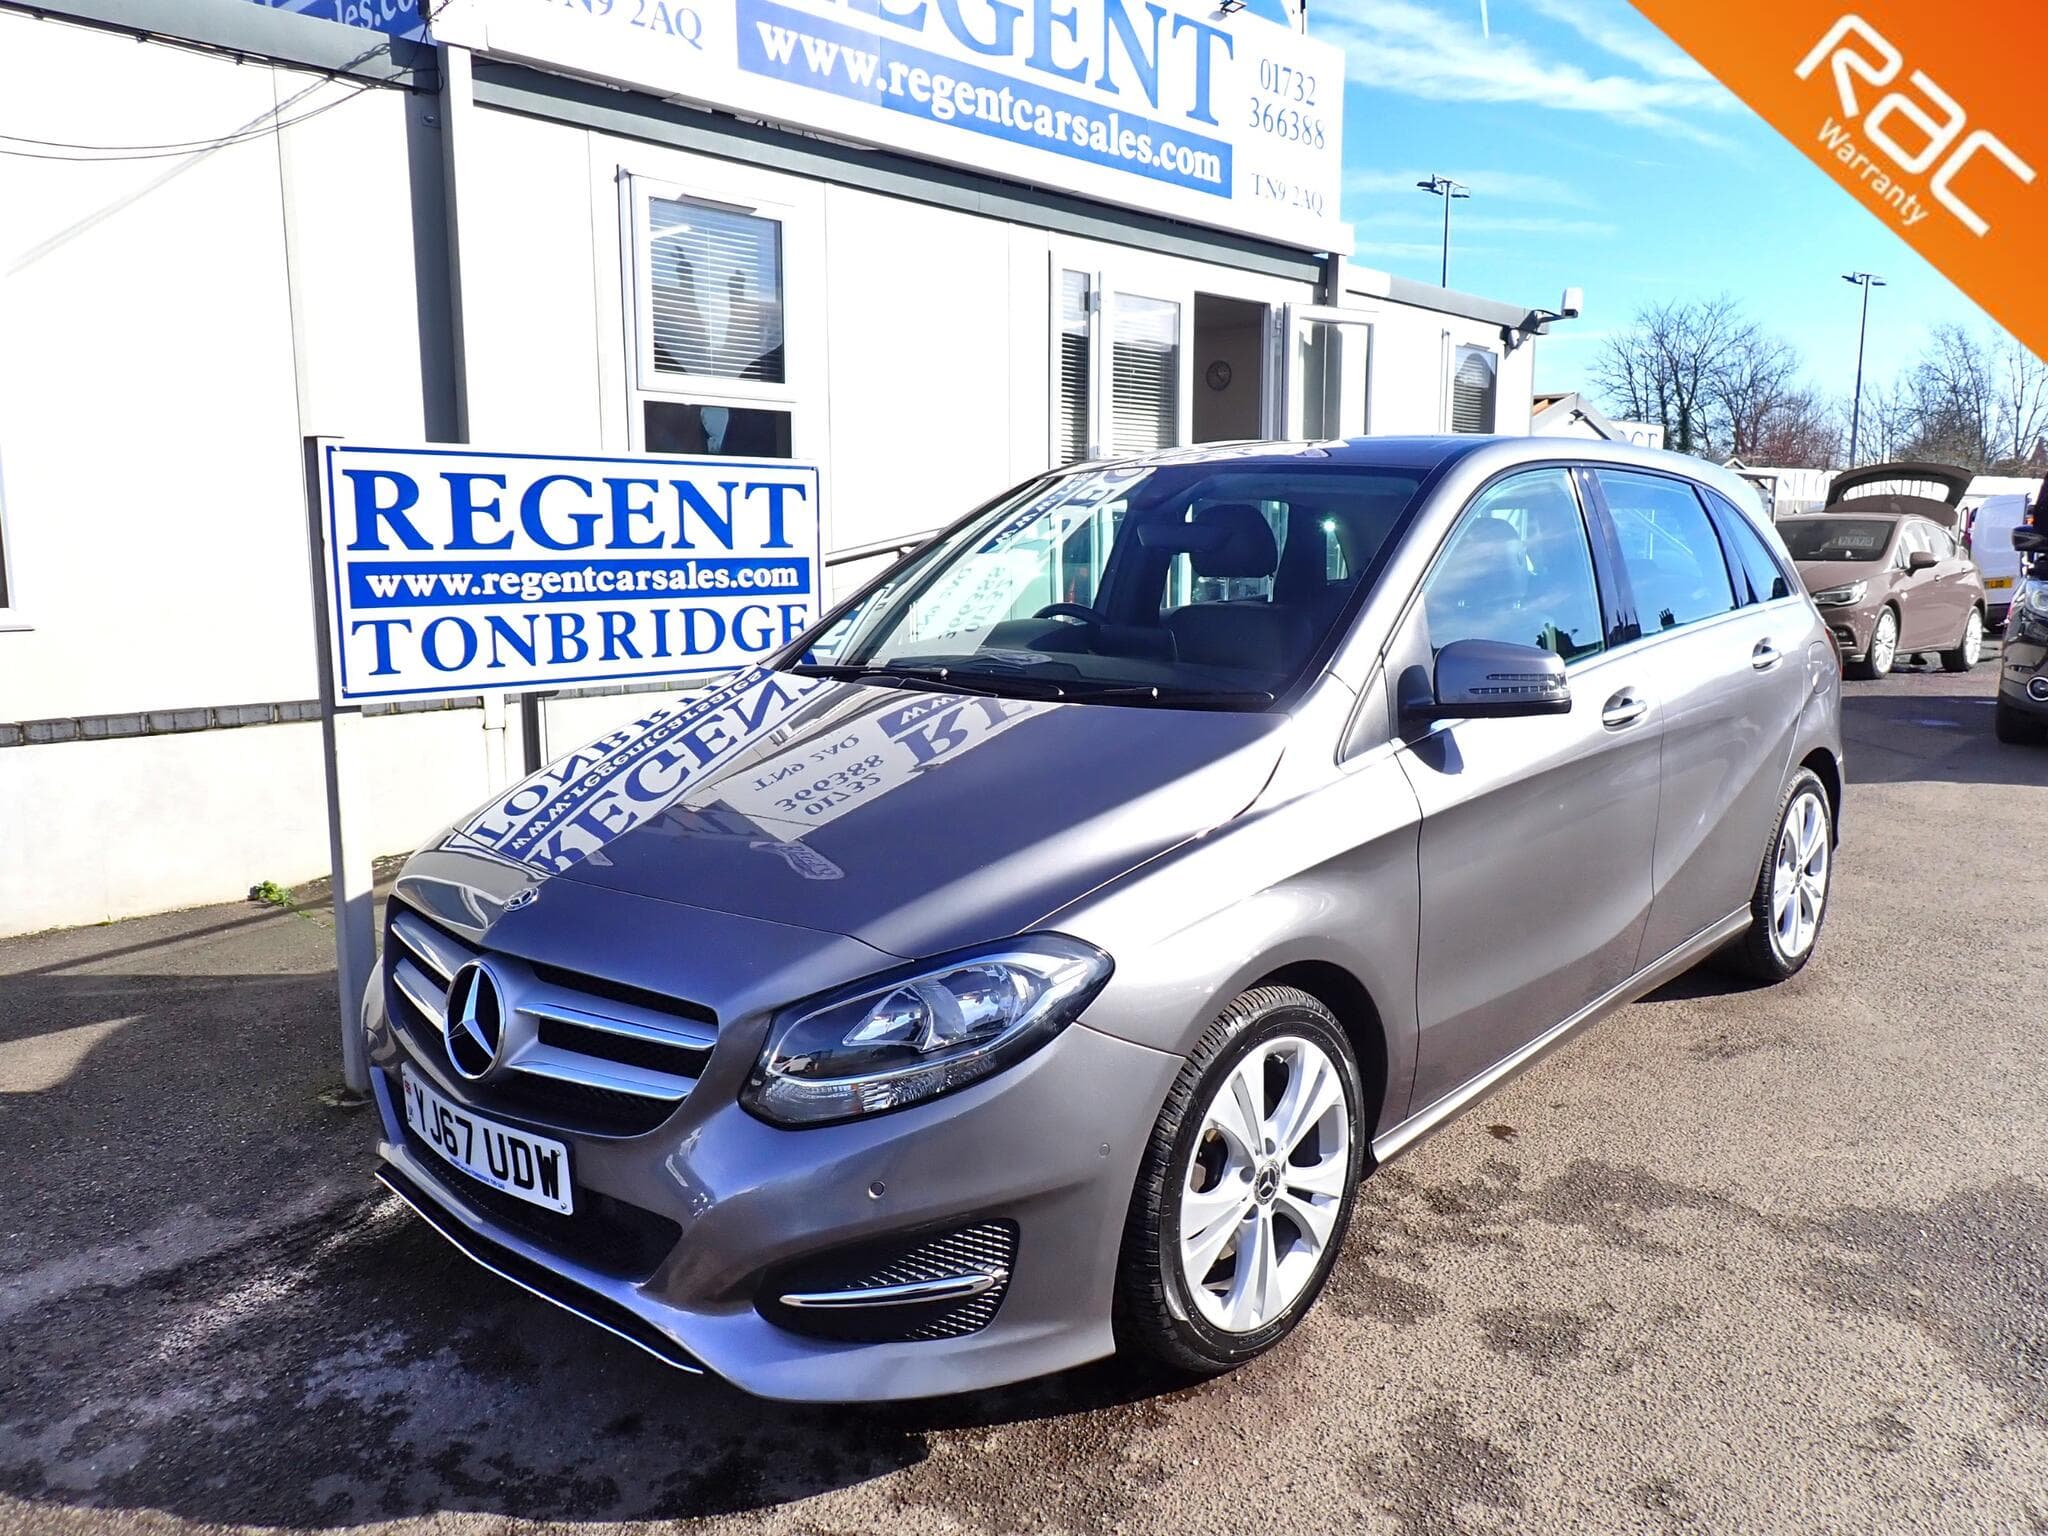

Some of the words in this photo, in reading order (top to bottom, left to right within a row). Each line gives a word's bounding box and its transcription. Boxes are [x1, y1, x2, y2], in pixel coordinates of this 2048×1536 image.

[756, 21, 1221, 184] www.regentcarsales.com
[1260, 58, 1316, 106] 01732
[1249, 97, 1325, 150] 366388
[342, 468, 807, 551] REGENT
[365, 561, 799, 600] www.regentcarsales.com
[413, 1082, 473, 1166] YJ67
[483, 1127, 560, 1201] UDW
